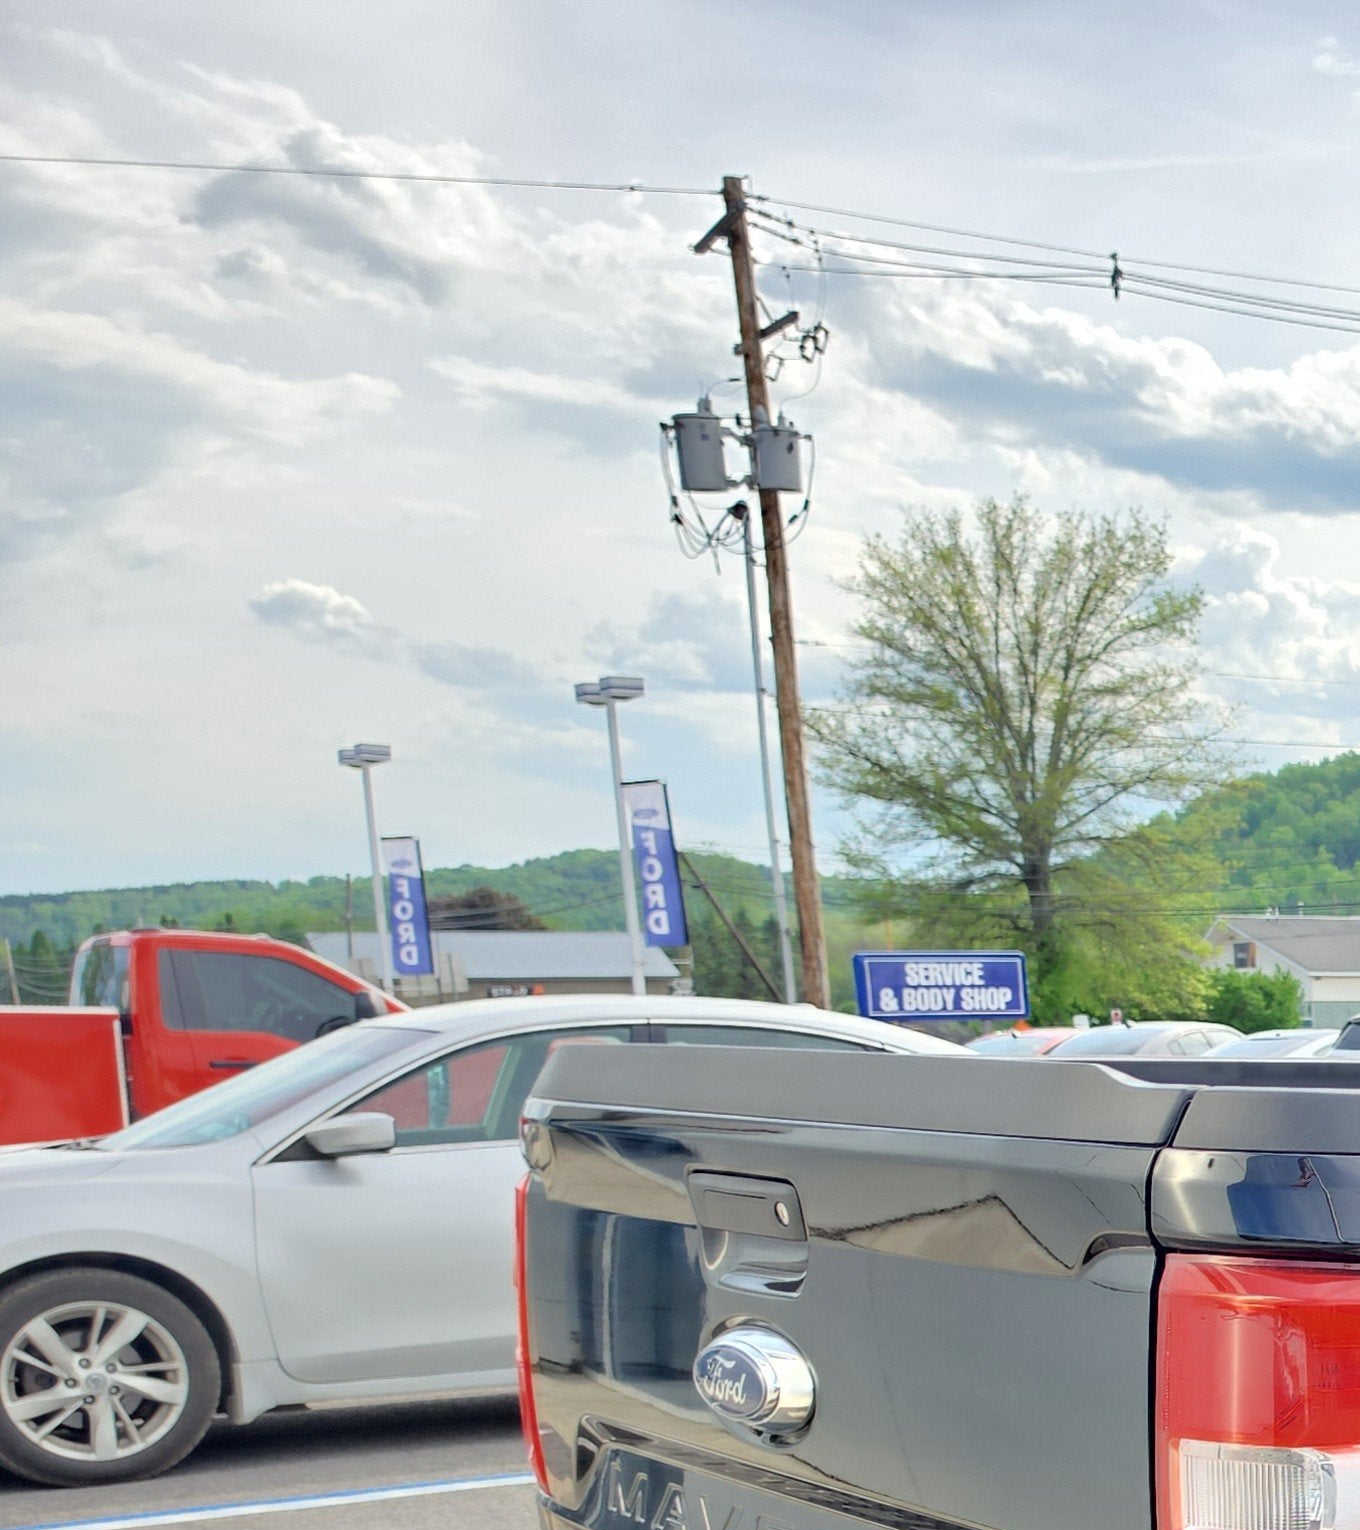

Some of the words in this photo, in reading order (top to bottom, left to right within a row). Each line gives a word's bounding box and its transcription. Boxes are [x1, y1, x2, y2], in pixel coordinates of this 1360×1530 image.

[904, 962, 986, 986] SERVICE
[879, 987, 899, 1012] &
[902, 987, 955, 1011] BODY
[960, 986, 1012, 1011] SHOP
[704, 1354, 746, 1405] Ford
